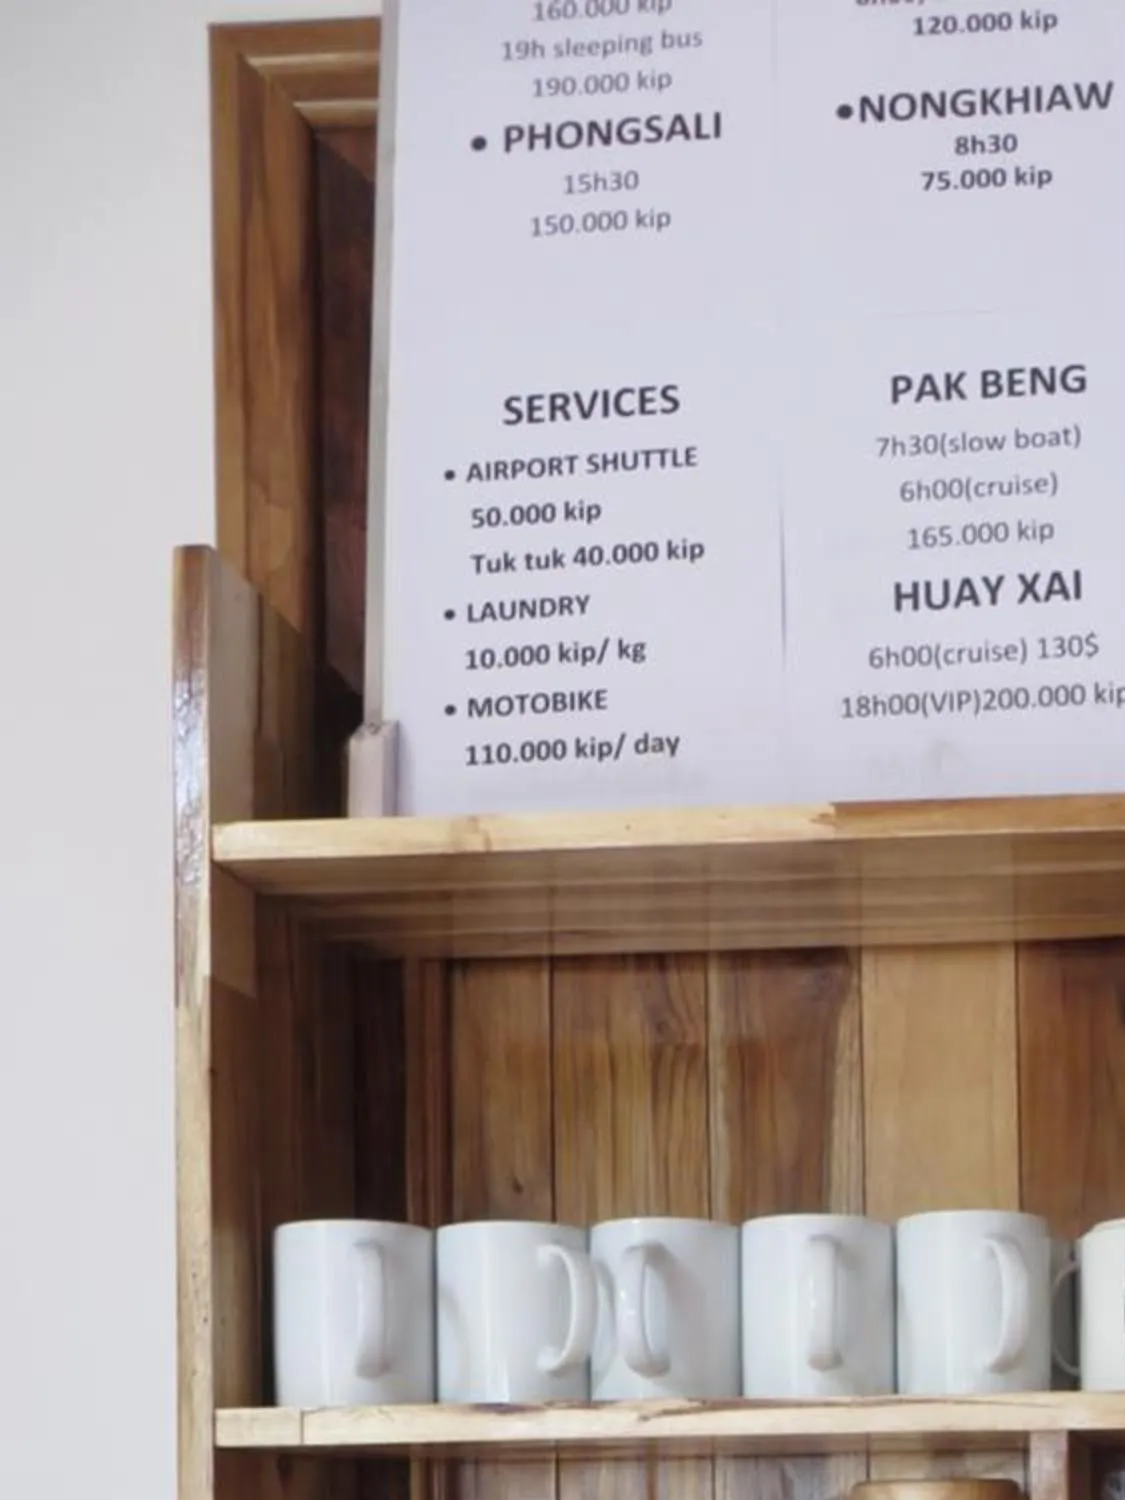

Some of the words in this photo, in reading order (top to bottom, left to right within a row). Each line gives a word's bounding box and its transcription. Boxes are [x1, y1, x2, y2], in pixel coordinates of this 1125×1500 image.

[534, 0, 630, 21] 160.000
[913, 11, 1014, 36] 120.000
[1020, 9, 1058, 34] kip
[503, 39, 545, 61] 19h
[553, 35, 653, 60] sleeping
[661, 29, 703, 49] bus
[533, 72, 630, 97] 190.000
[636, 70, 672, 93] kip
[503, 111, 722, 155] PHONGSALI
[954, 133, 1018, 156] 8h30
[564, 170, 639, 195] 15h30
[920, 167, 1008, 192] 75.000
[1014, 165, 1053, 190] kip
[532, 210, 629, 237] 150.000
[635, 208, 671, 232] kip
[890, 370, 968, 406] PAK
[980, 363, 1087, 400] BENG
[502, 384, 681, 427] SERVICES
[876, 431, 1007, 458] 7h30(slow
[1014, 423, 1081, 450] boat)
[465, 454, 580, 484] AIRPORT
[585, 446, 698, 475] SHUTTLE
[900, 471, 1058, 503] 6h00(cruise)
[470, 502, 557, 529] 50.000
[563, 498, 603, 527] kip
[908, 521, 1010, 550] 165.000
[1017, 519, 1055, 545] kip
[469, 550, 517, 576] Tuk
[524, 546, 566, 572] tuk
[572, 541, 660, 568] 40.000
[666, 537, 705, 564] kip
[894, 574, 1006, 614] HUAY
[1017, 569, 1082, 605] XAI
[467, 594, 591, 624] LAUNDRY
[465, 643, 551, 671] 10.000
[617, 637, 647, 664] kg
[868, 637, 1028, 671] 6h00(cruise)
[1038, 631, 1100, 660] 130$
[467, 688, 608, 719] MOTOBIKE
[465, 738, 568, 766] 110.000
[633, 732, 681, 759] day
